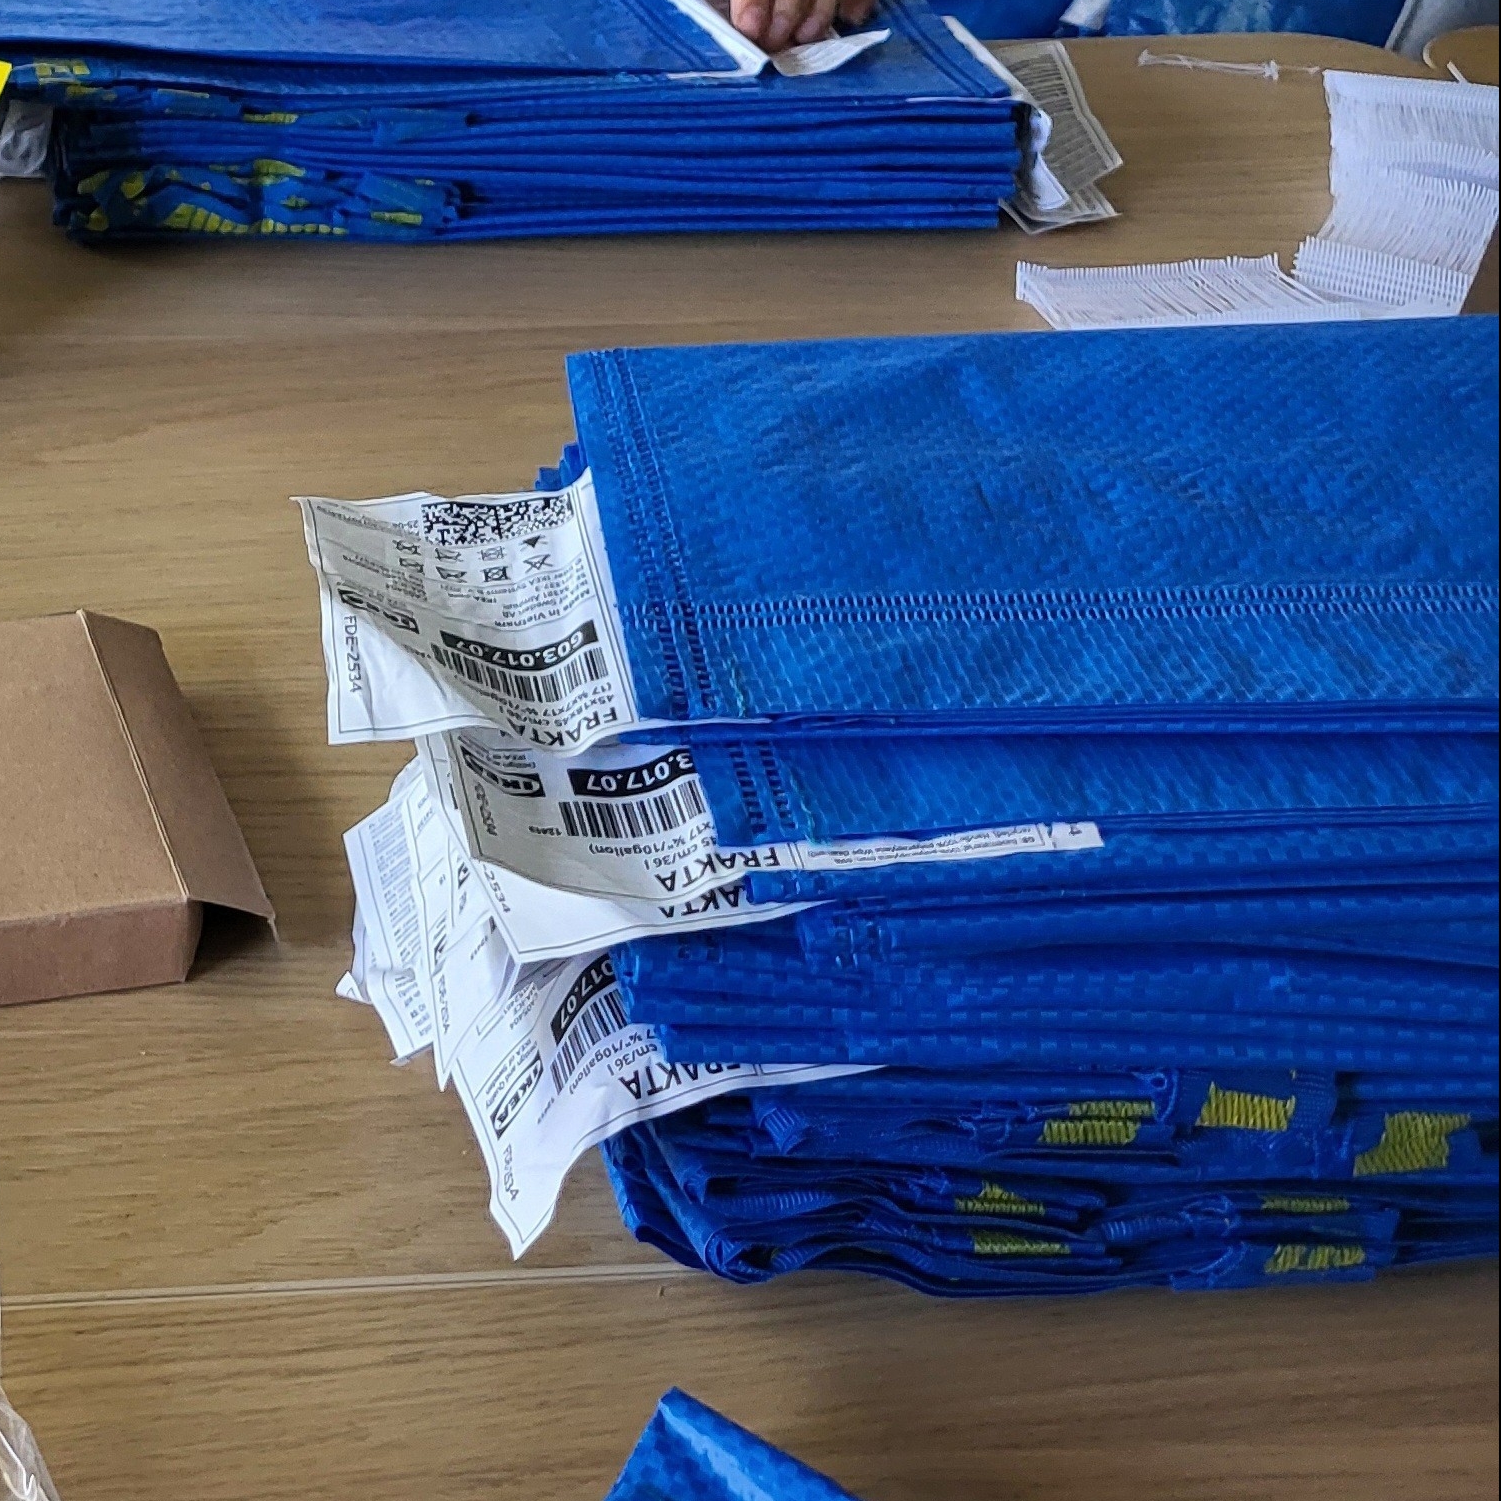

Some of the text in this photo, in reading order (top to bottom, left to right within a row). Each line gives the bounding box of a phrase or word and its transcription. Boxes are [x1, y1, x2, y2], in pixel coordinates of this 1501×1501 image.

[343, 615, 363, 693] FDE-2534
[456, 629, 584, 667] 603.017.07
[507, 706, 618, 747] FRAKTA
[654, 846, 781, 892] FRAKTA
[495, 1061, 541, 1127] IKEA
